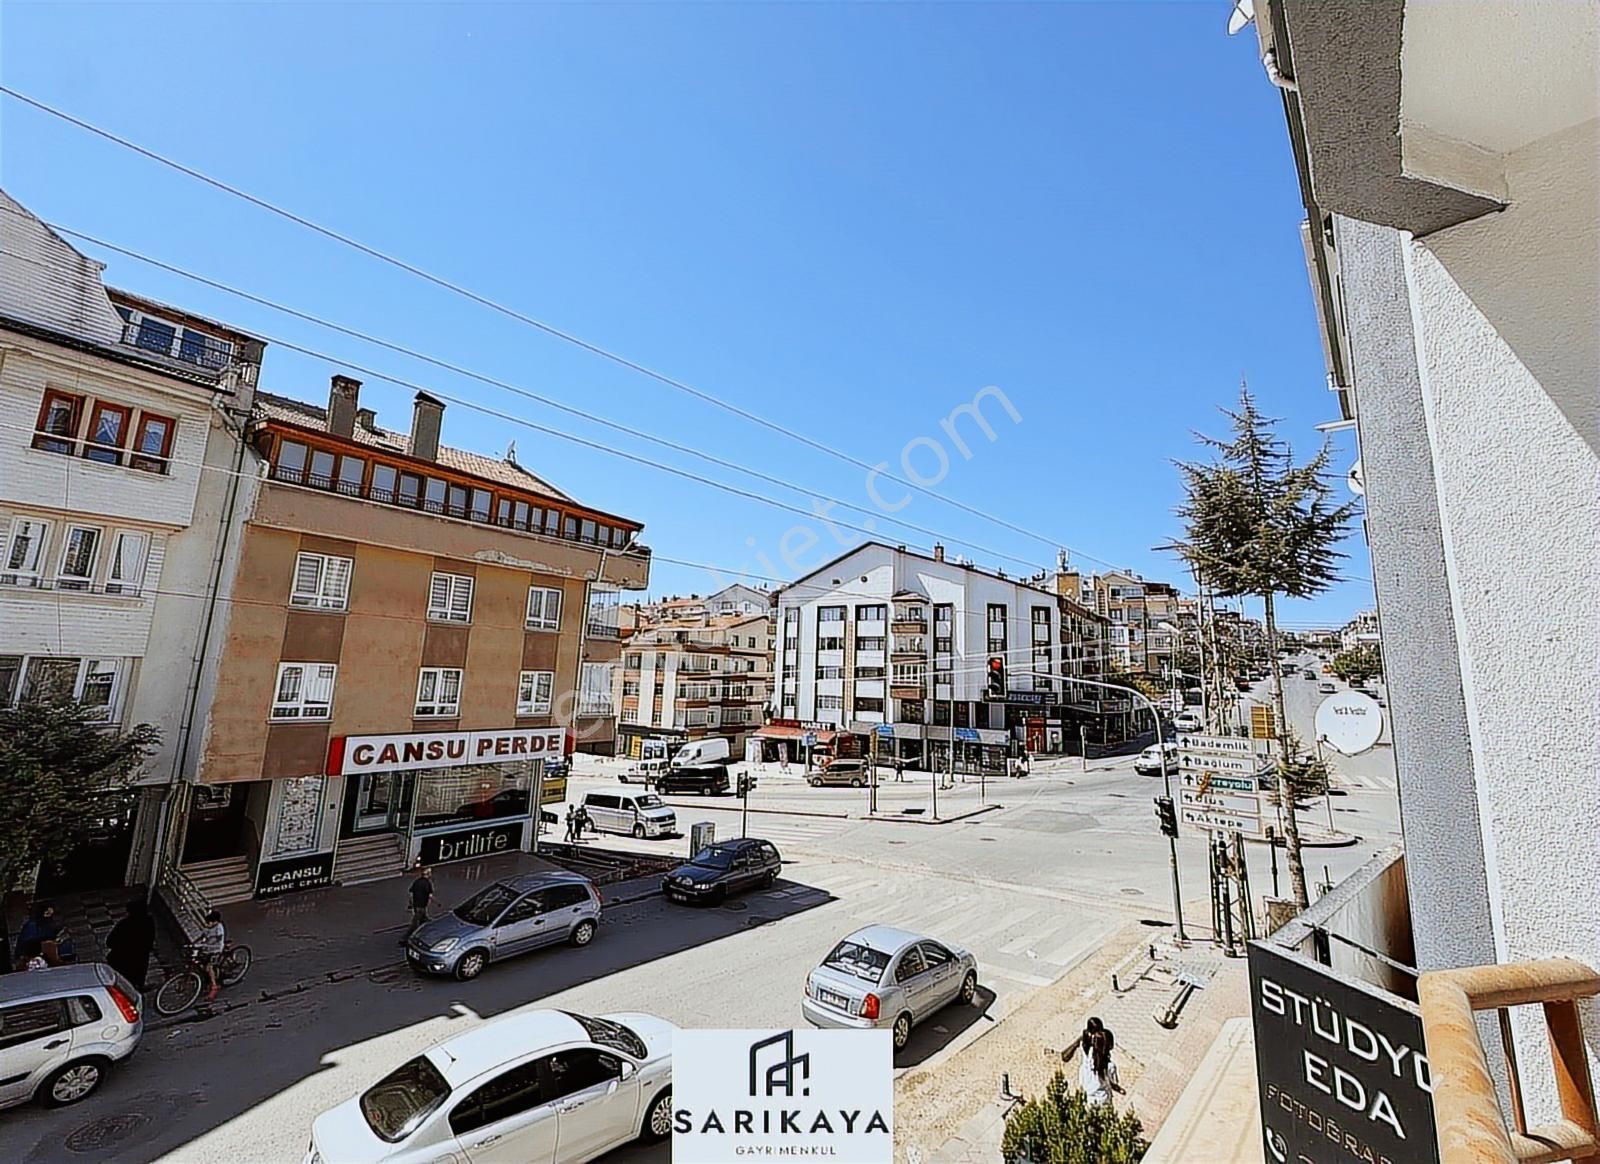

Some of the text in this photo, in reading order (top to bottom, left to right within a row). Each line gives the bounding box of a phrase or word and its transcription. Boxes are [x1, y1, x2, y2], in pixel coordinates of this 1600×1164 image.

[352, 734, 561, 766] CANSU PERDE
[1192, 738, 1249, 751] Bademlik
[1197, 814, 1244, 828] Aktepe
[438, 830, 508, 862] brillife
[272, 866, 322, 883] CANSU
[1261, 977, 1433, 1094] STÜDYO
[1304, 1050, 1406, 1139] EDA
